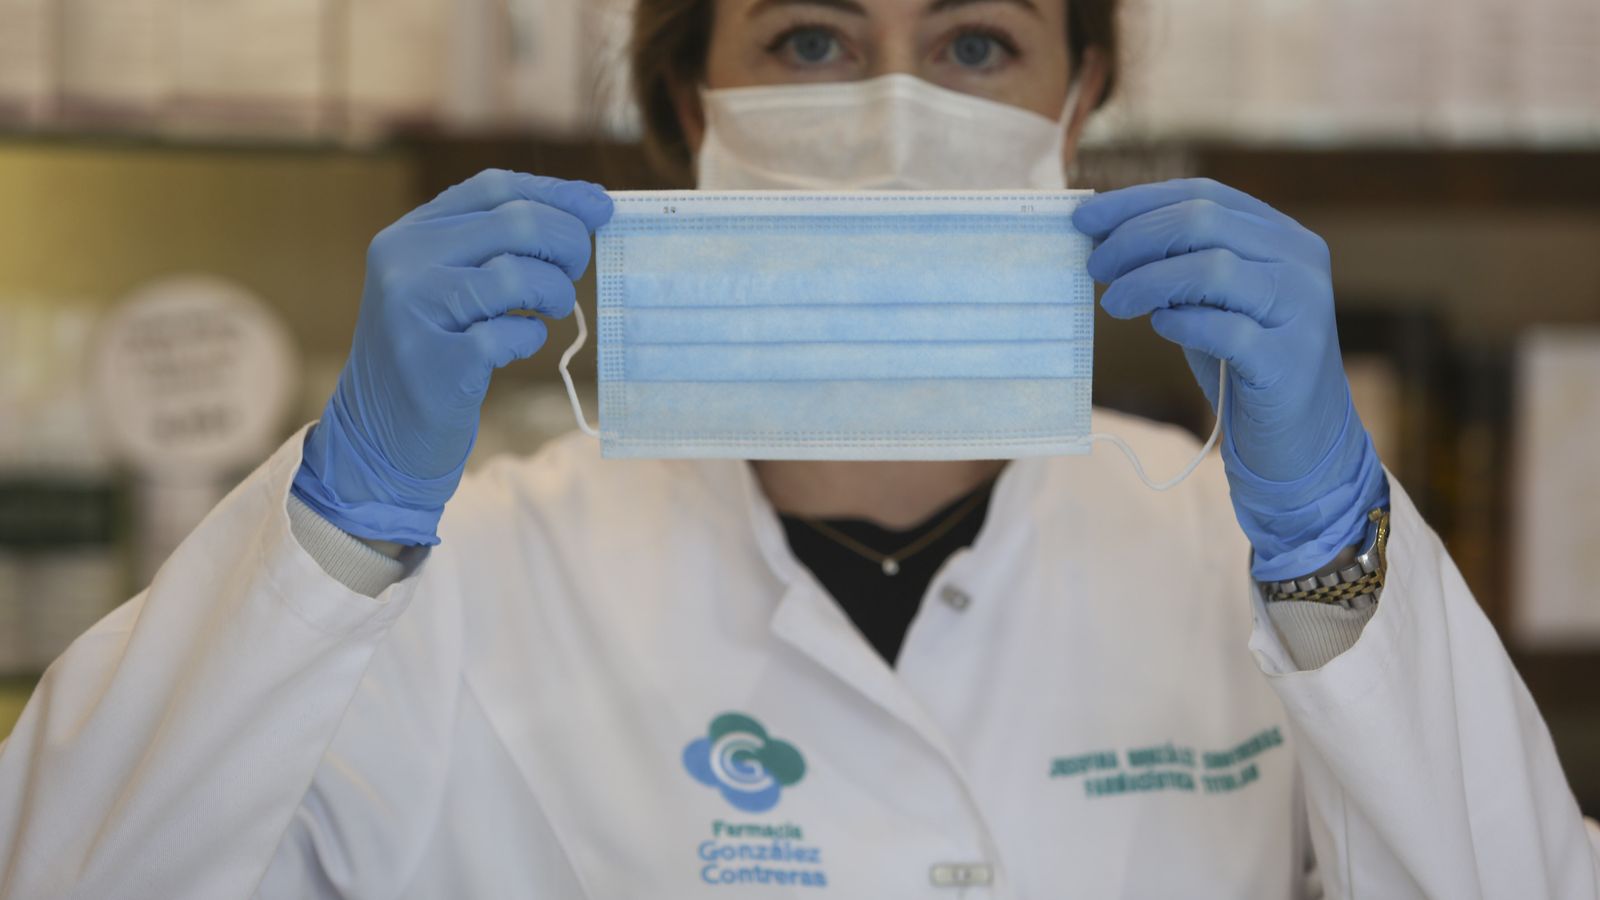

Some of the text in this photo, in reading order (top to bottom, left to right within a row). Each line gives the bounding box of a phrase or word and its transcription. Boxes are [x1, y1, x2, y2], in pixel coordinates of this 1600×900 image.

[712, 820, 803, 839] Farmacia
[698, 840, 821, 863] González
[702, 864, 827, 887] Contreras
